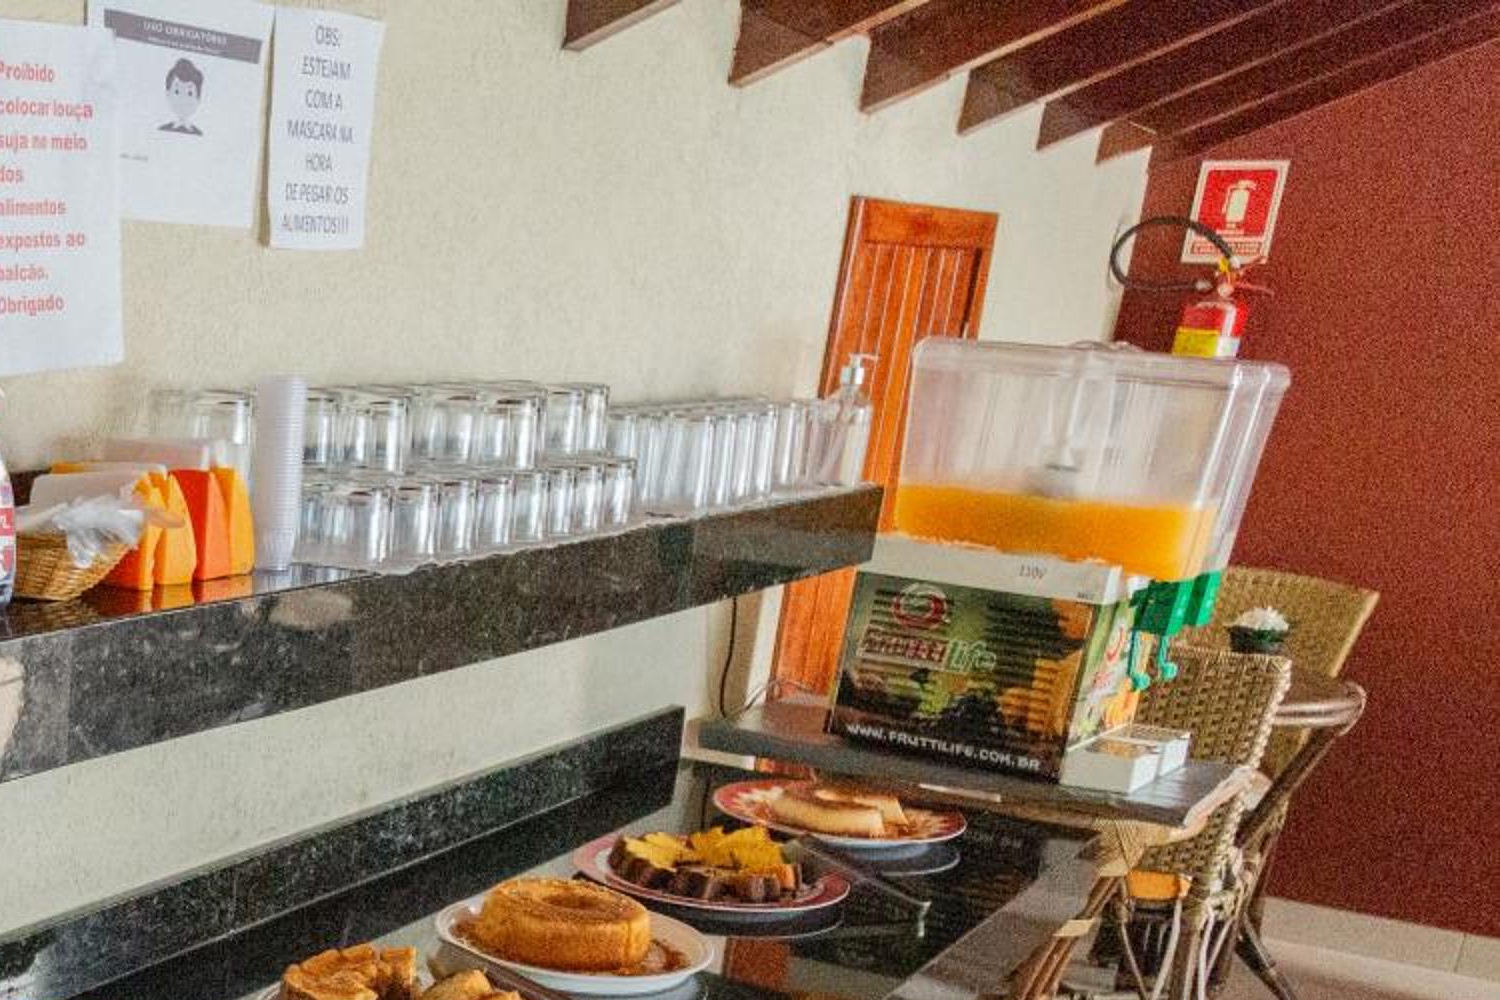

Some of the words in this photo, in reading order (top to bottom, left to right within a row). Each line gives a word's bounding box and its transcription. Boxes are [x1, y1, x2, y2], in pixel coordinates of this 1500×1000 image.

[53, 100, 93, 122] louça
[51, 134, 88, 151] meio
[305, 153, 333, 172] HORA
[285, 183, 298, 201] DE
[333, 185, 349, 205] OS
[66, 233, 86, 248] ao
